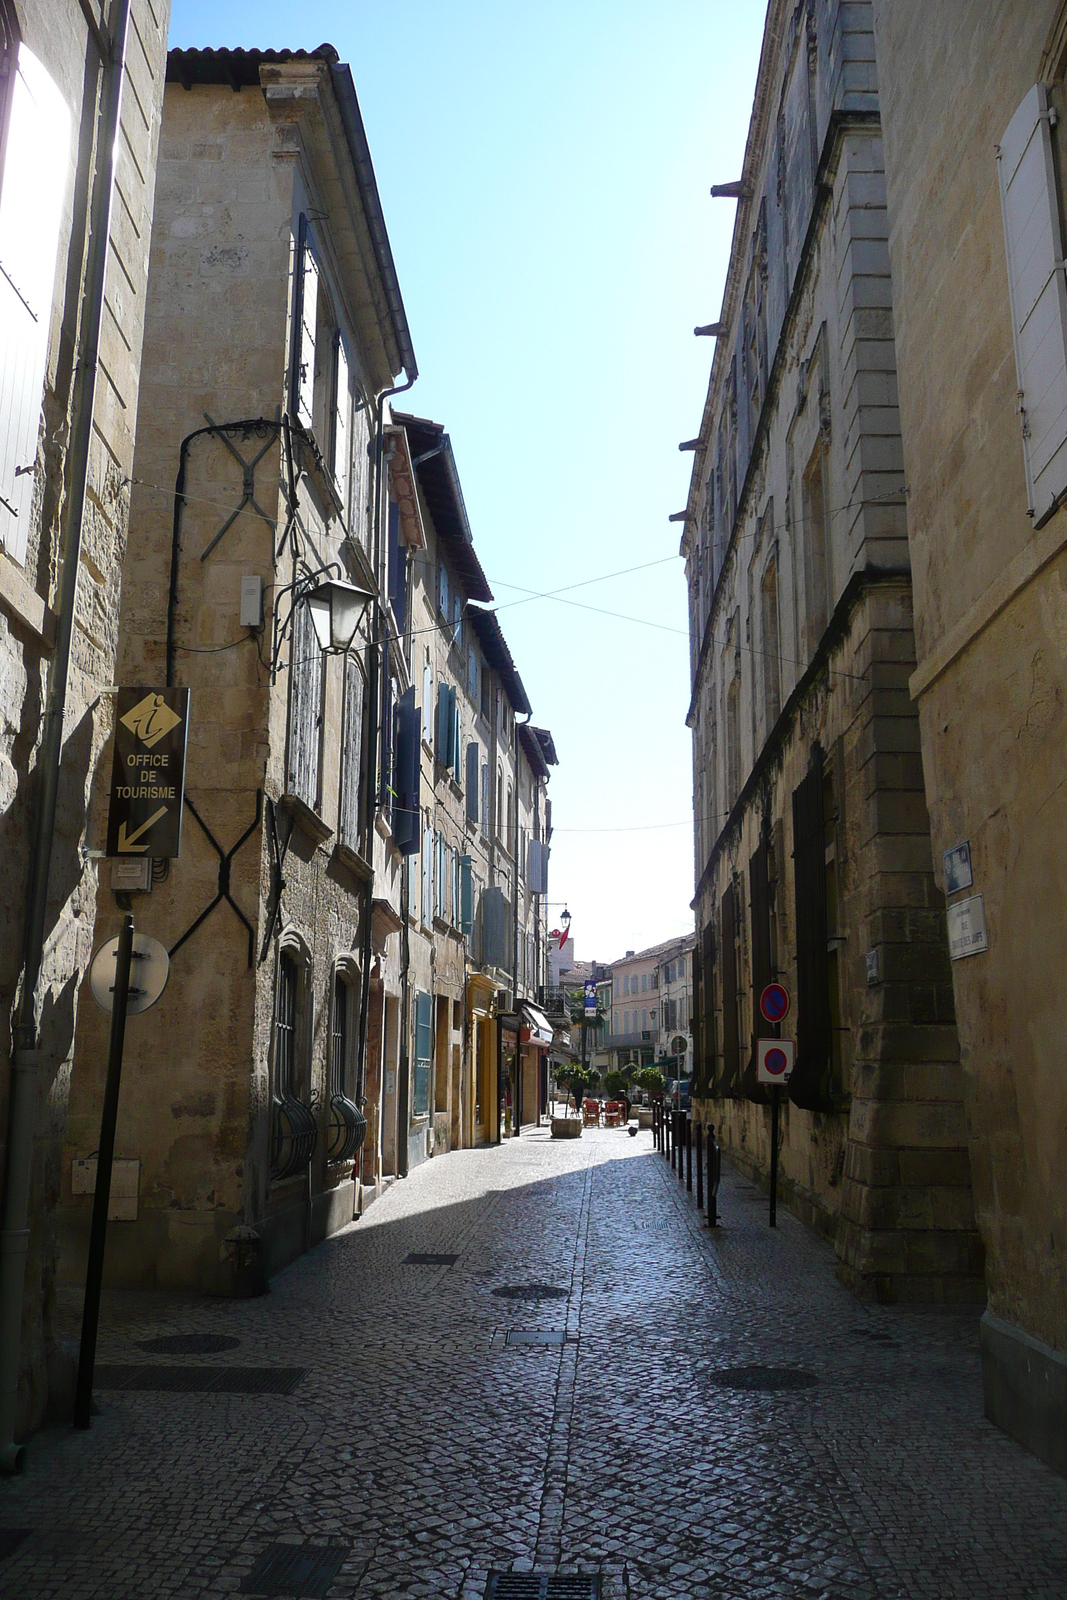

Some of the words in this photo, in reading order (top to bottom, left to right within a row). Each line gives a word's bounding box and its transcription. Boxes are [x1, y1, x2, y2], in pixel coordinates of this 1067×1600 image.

[127, 755, 168, 766] OFFICE
[141, 771, 156, 782] DE
[116, 787, 175, 798] TOURISME
